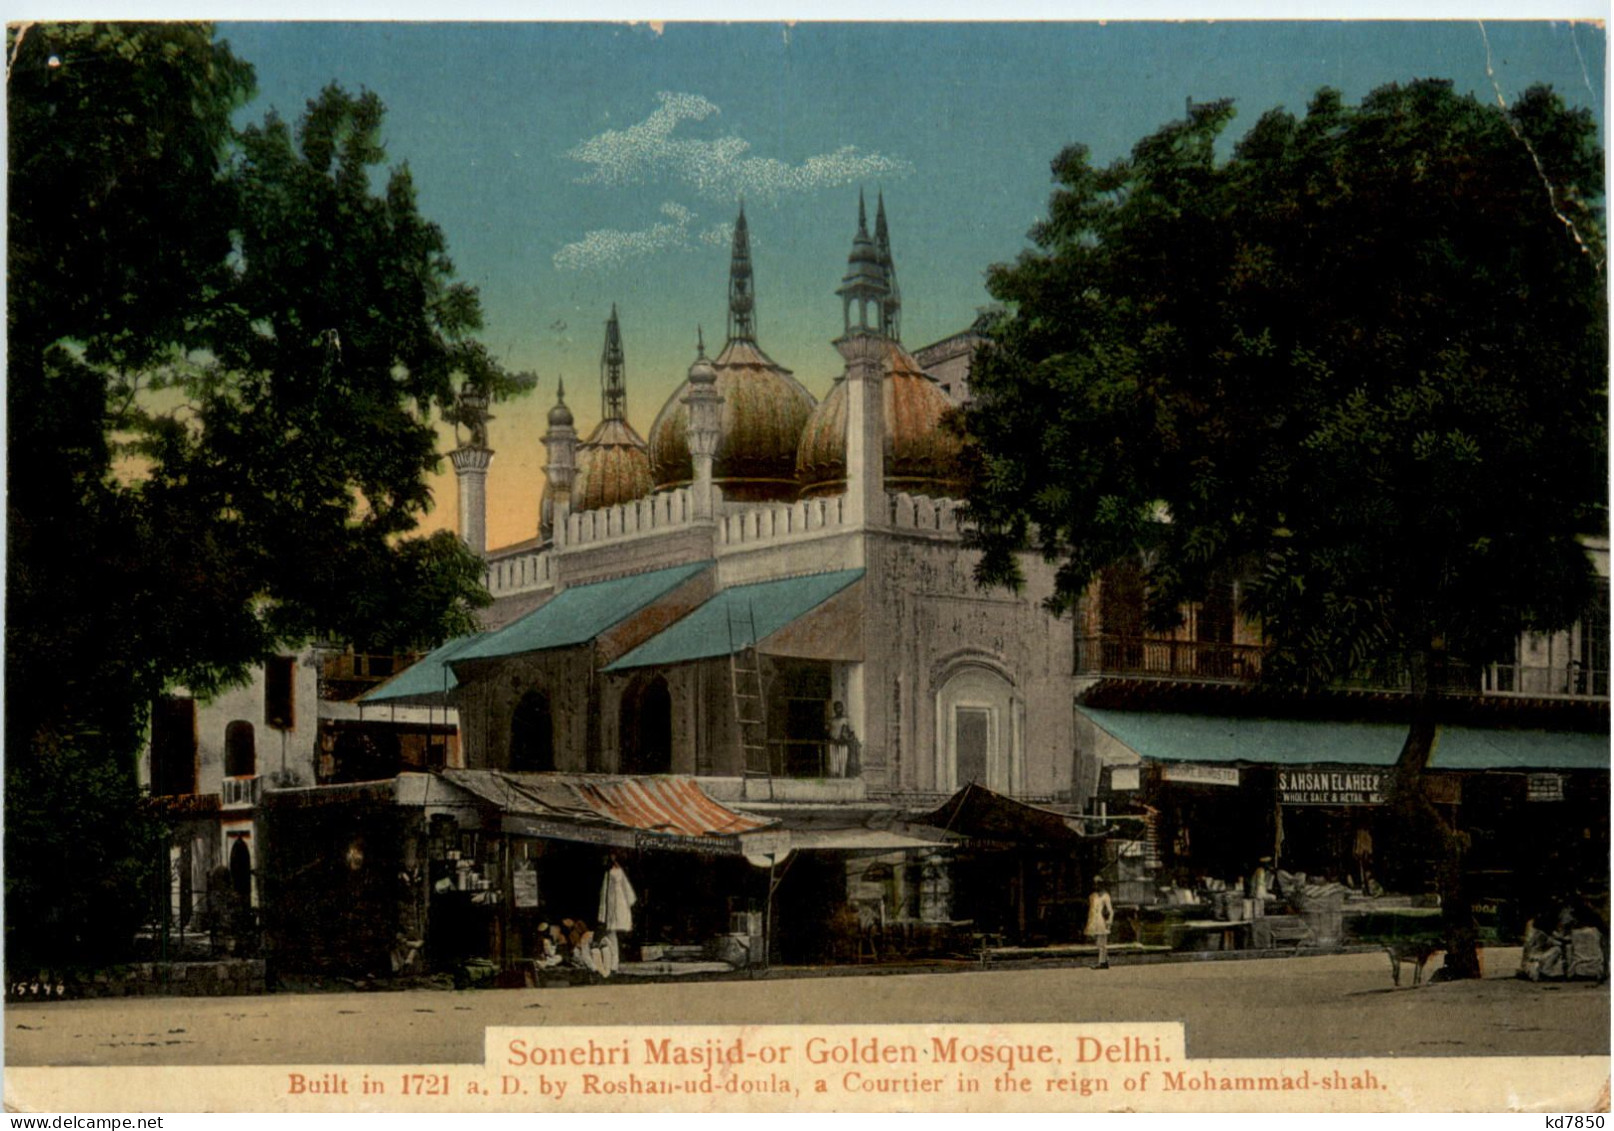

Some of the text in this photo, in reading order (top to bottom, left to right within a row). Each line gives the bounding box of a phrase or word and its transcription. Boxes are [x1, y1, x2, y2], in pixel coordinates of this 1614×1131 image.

[1283, 792, 1308, 802] WHOLE
[1310, 792, 1328, 802] SALE
[1331, 792, 1338, 802] &
[1340, 792, 1364, 802] RETAIL
